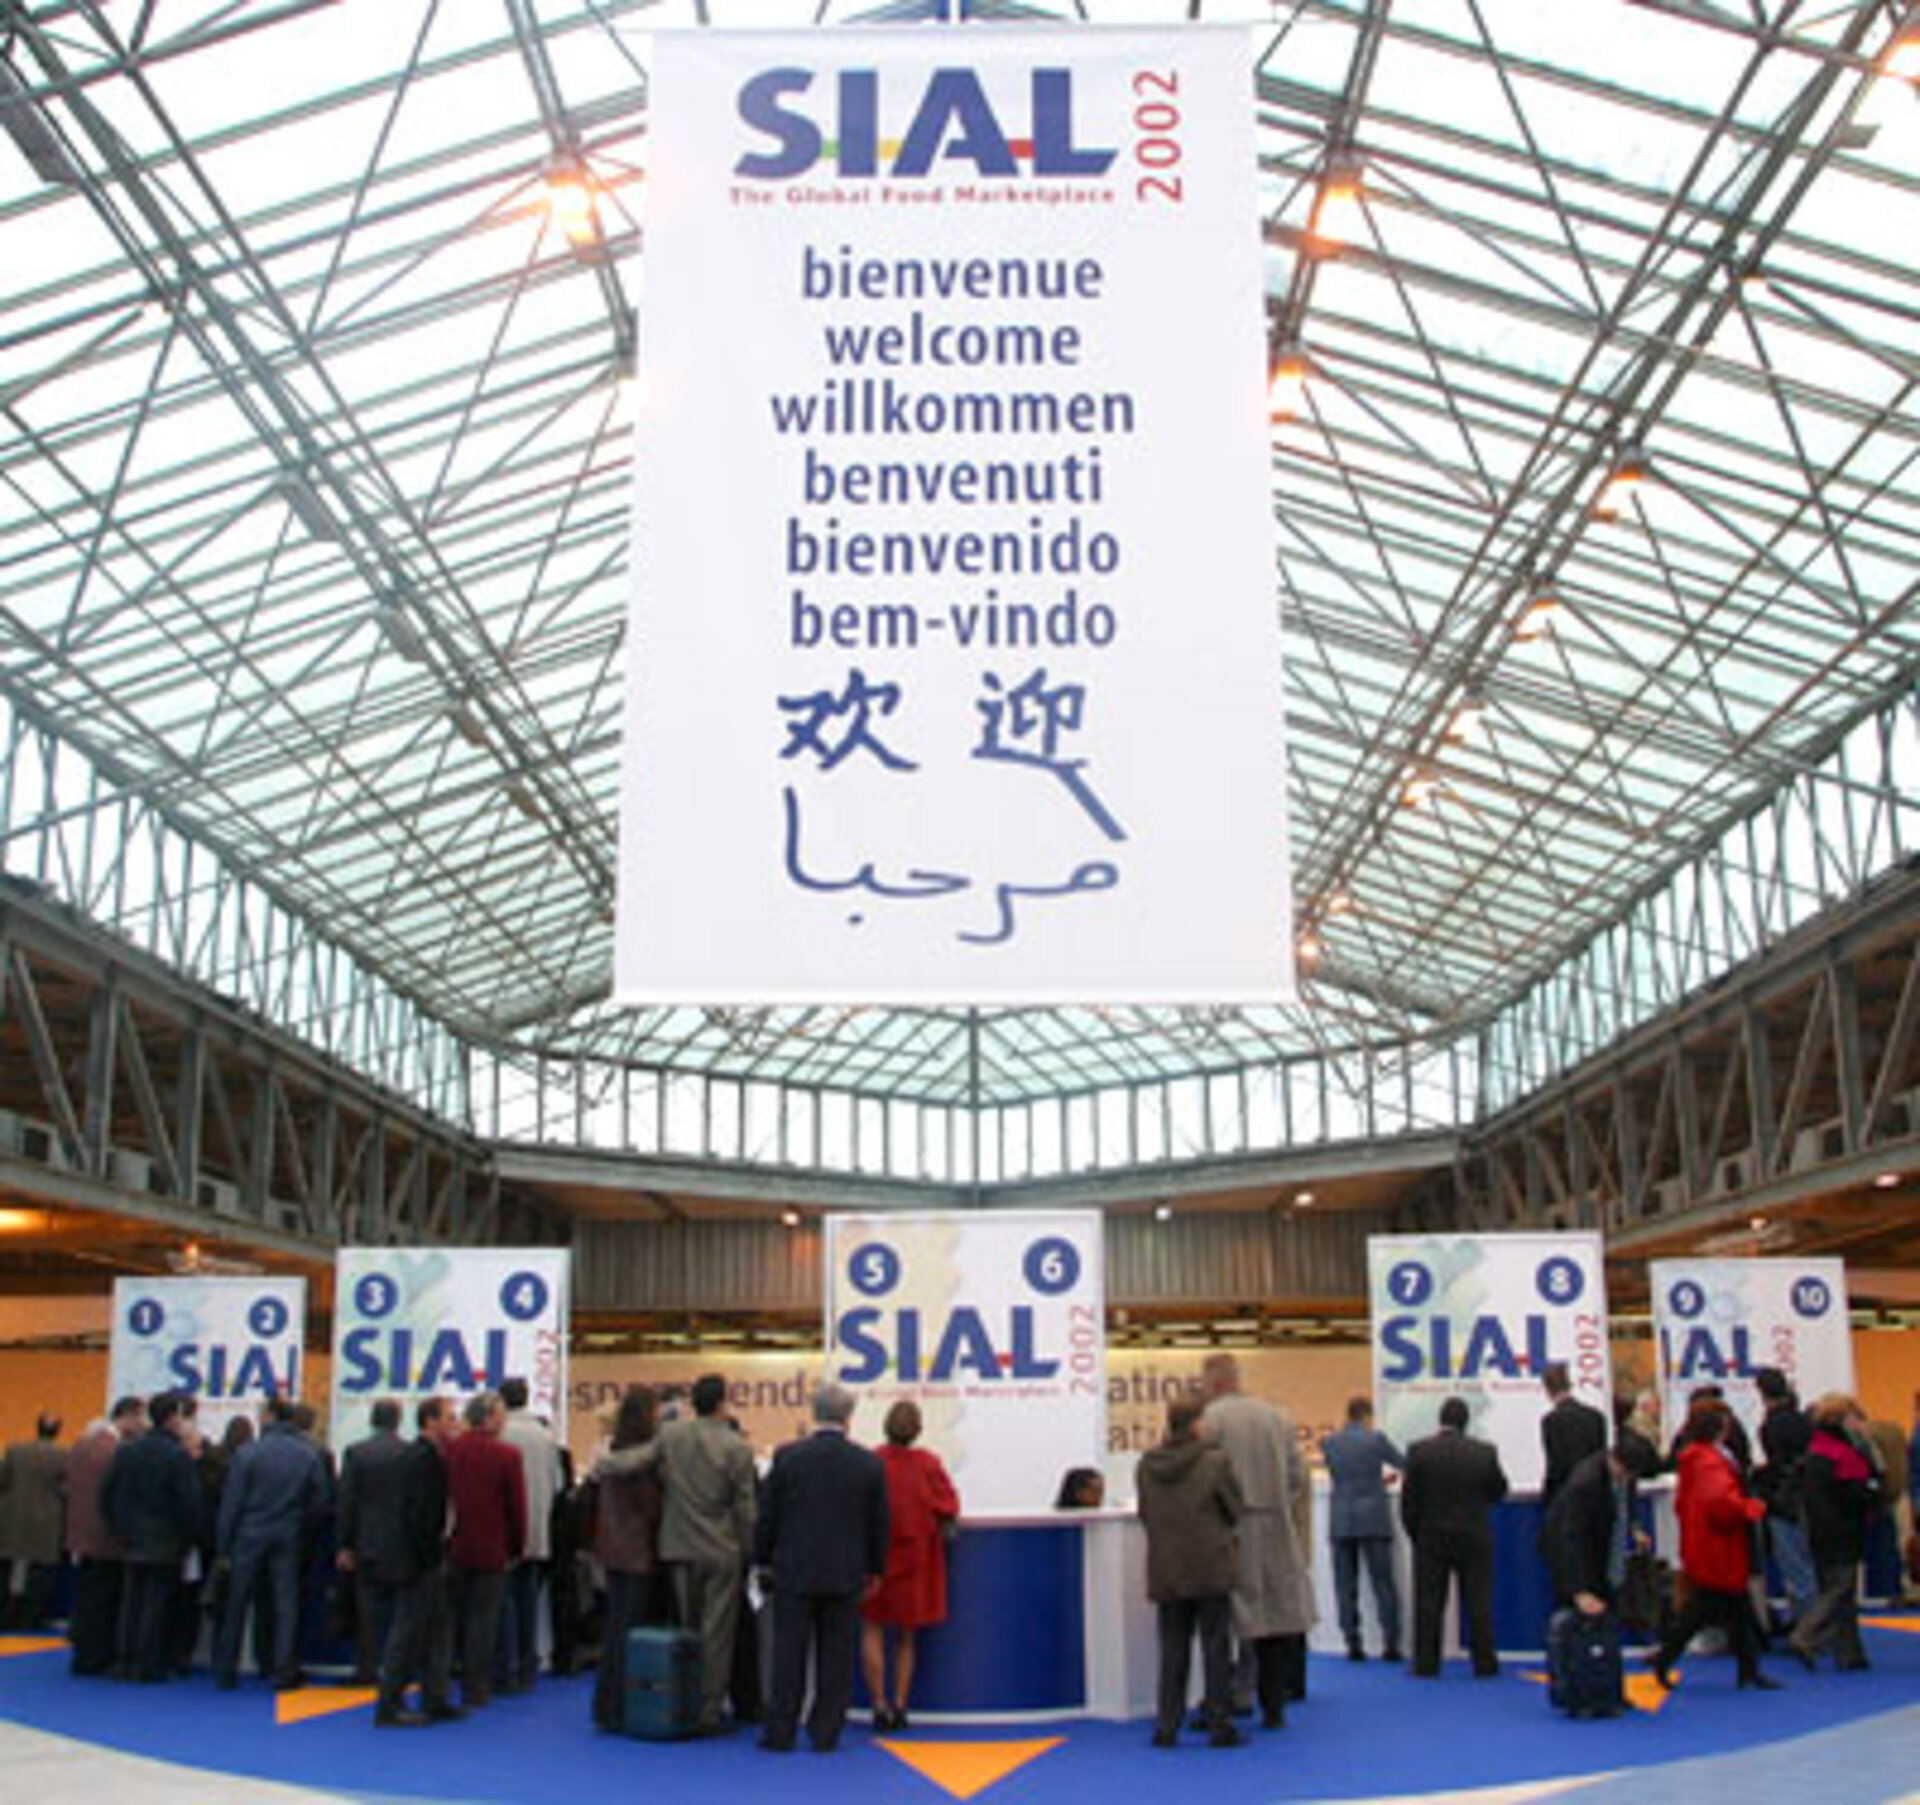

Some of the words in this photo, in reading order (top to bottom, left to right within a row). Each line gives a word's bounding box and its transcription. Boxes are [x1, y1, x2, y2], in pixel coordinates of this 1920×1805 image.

[733, 66, 1119, 180] SIAL
[1132, 69, 1184, 202] 2002
[729, 186, 775, 204] The
[785, 186, 870, 204] Global
[881, 186, 943, 204] Food
[954, 186, 1116, 207] Marketplace
[803, 245, 1101, 298] bienvenue
[825, 311, 1081, 365] welcome
[771, 378, 1134, 434] willkommen
[803, 448, 1102, 502] benvenuti
[786, 518, 1119, 574] bienvenido
[790, 590, 1116, 647] bem-vindo
[863, 1253, 884, 1286] 5
[1040, 1249, 1062, 1282] 6
[1550, 1266, 1570, 1294] 8
[366, 1281, 385, 1311] 3
[514, 1282, 534, 1309] 4
[1400, 1270, 1418, 1297] 7
[1678, 1286, 1695, 1312] 9
[1798, 1286, 1824, 1309] 10
[139, 1306, 151, 1330] 1
[260, 1305, 276, 1329] 2
[837, 1305, 1061, 1383] SIAL
